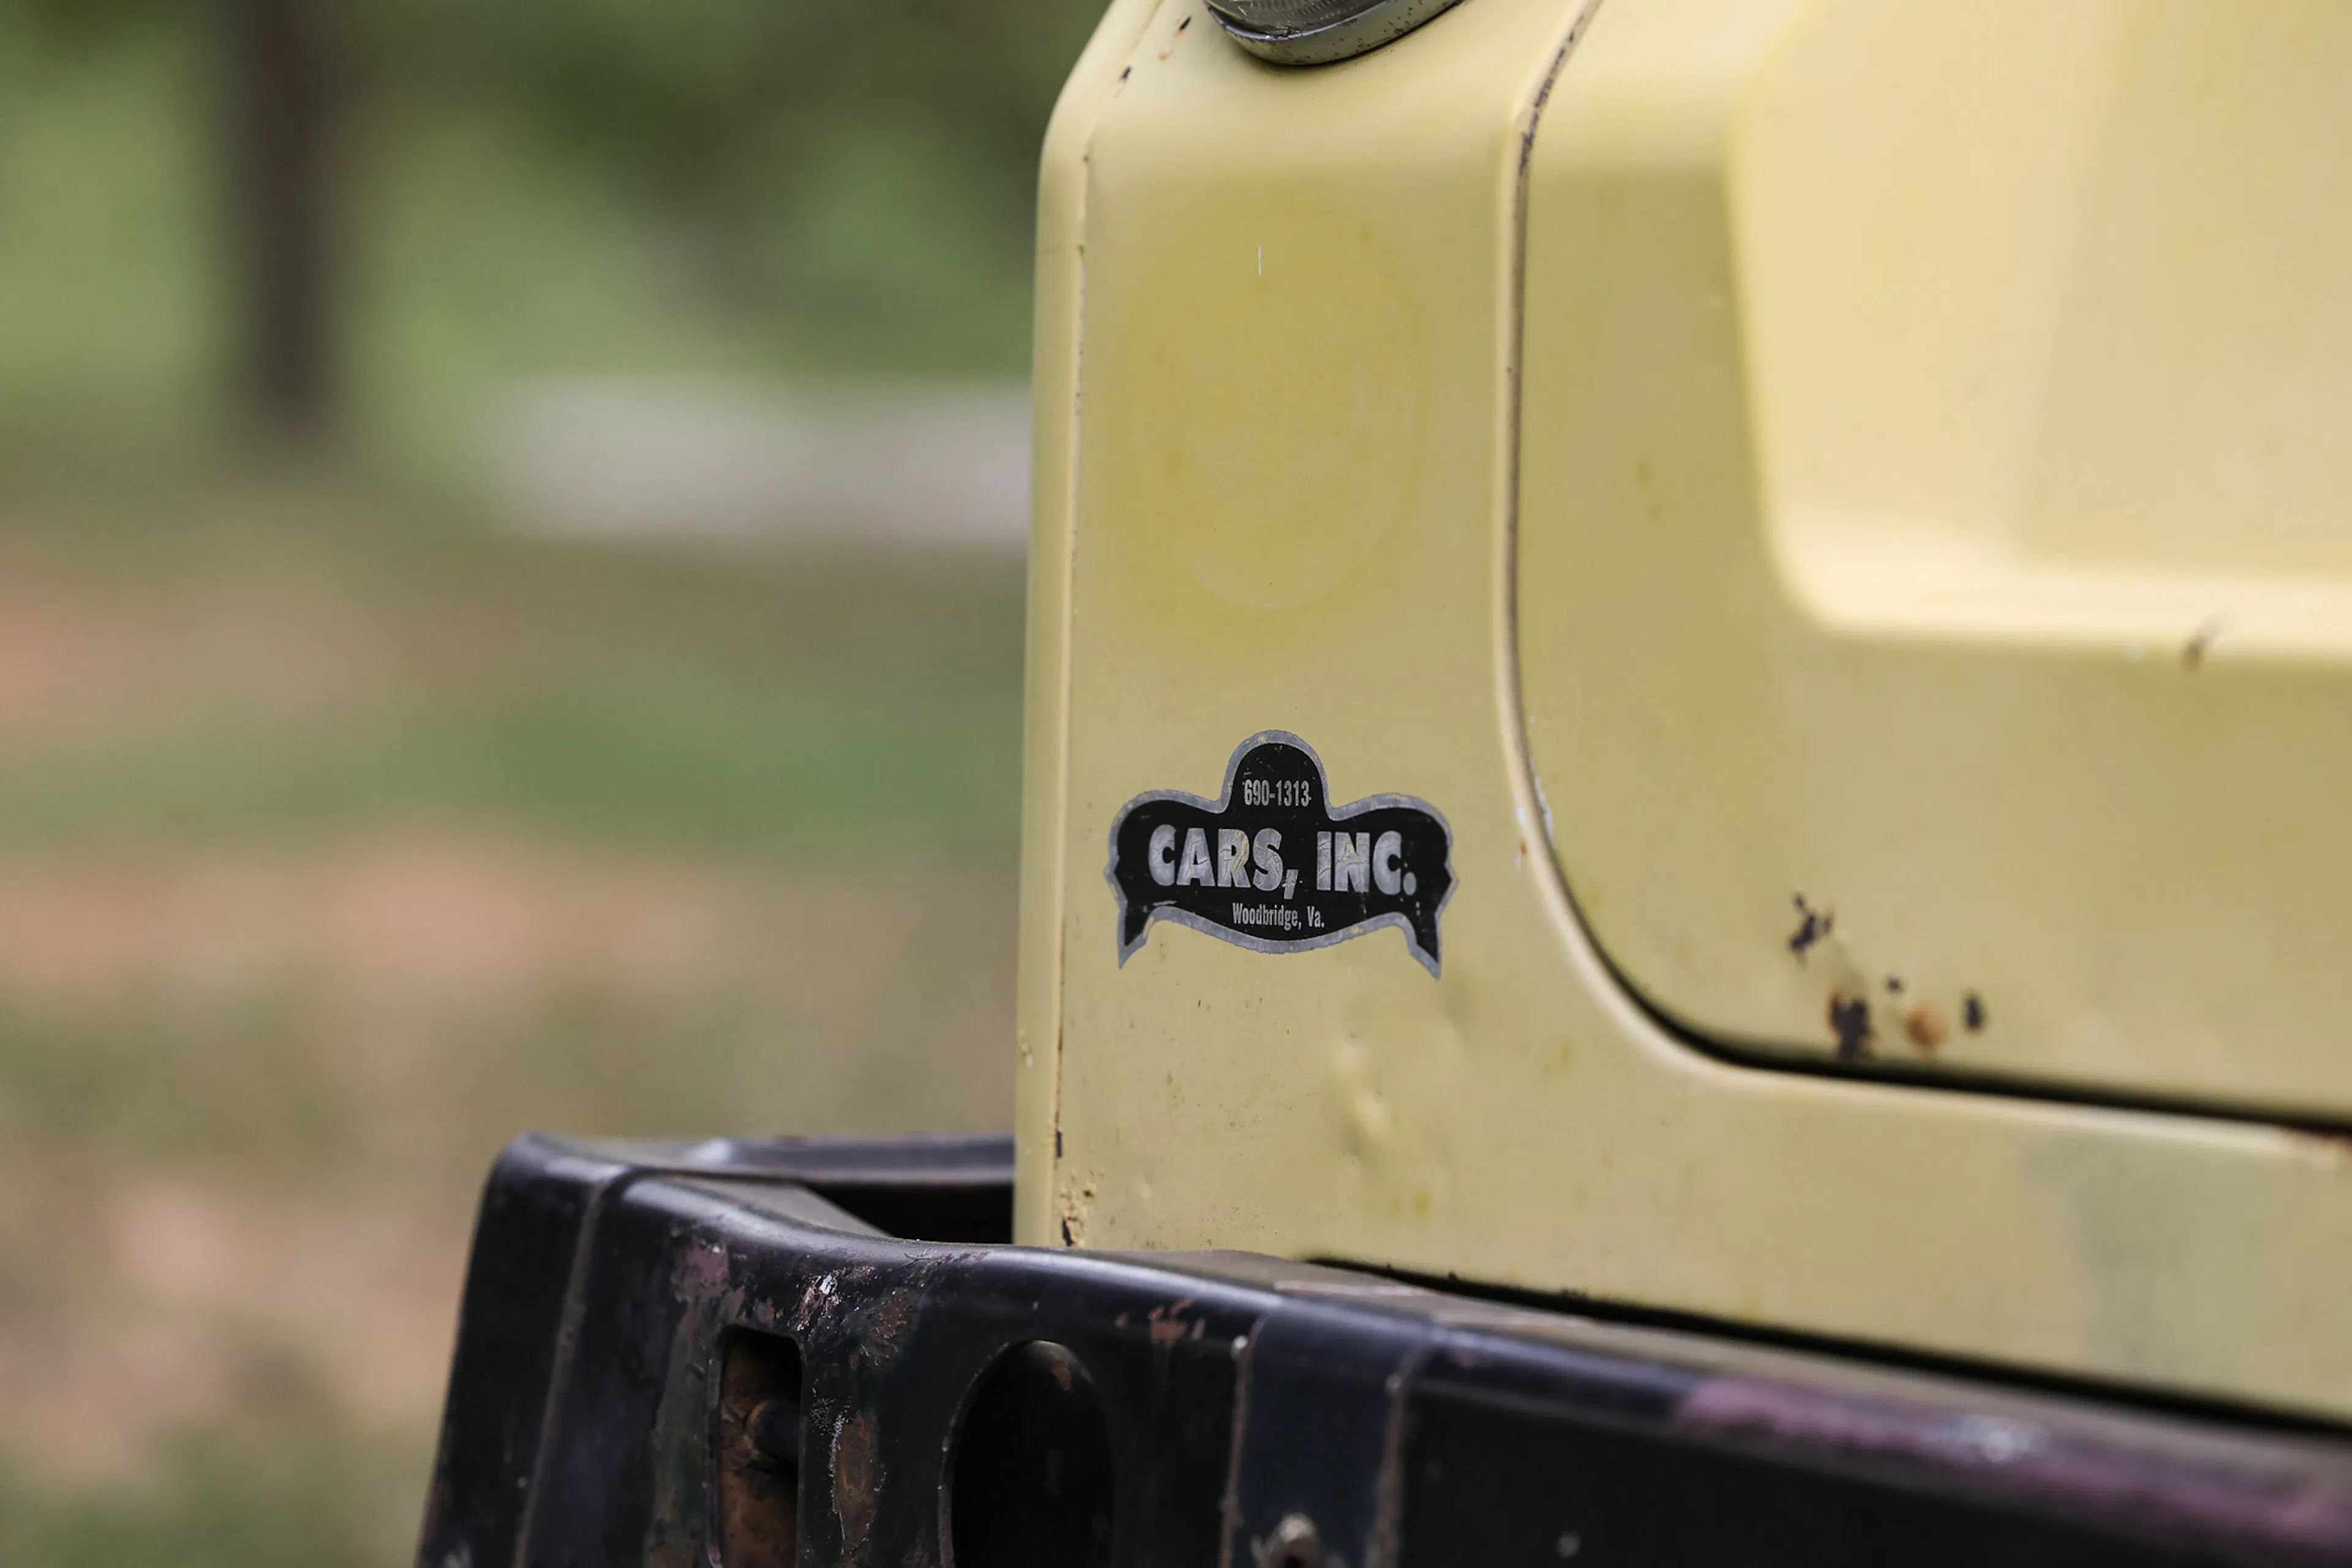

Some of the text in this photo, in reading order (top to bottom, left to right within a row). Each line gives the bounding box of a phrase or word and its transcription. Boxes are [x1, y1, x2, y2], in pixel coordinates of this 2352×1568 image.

[1244, 779, 1309, 807] 690-1313
[1148, 824, 1417, 899] CARS, INC.
[1232, 902, 1325, 930] Woodbridge, Va.
